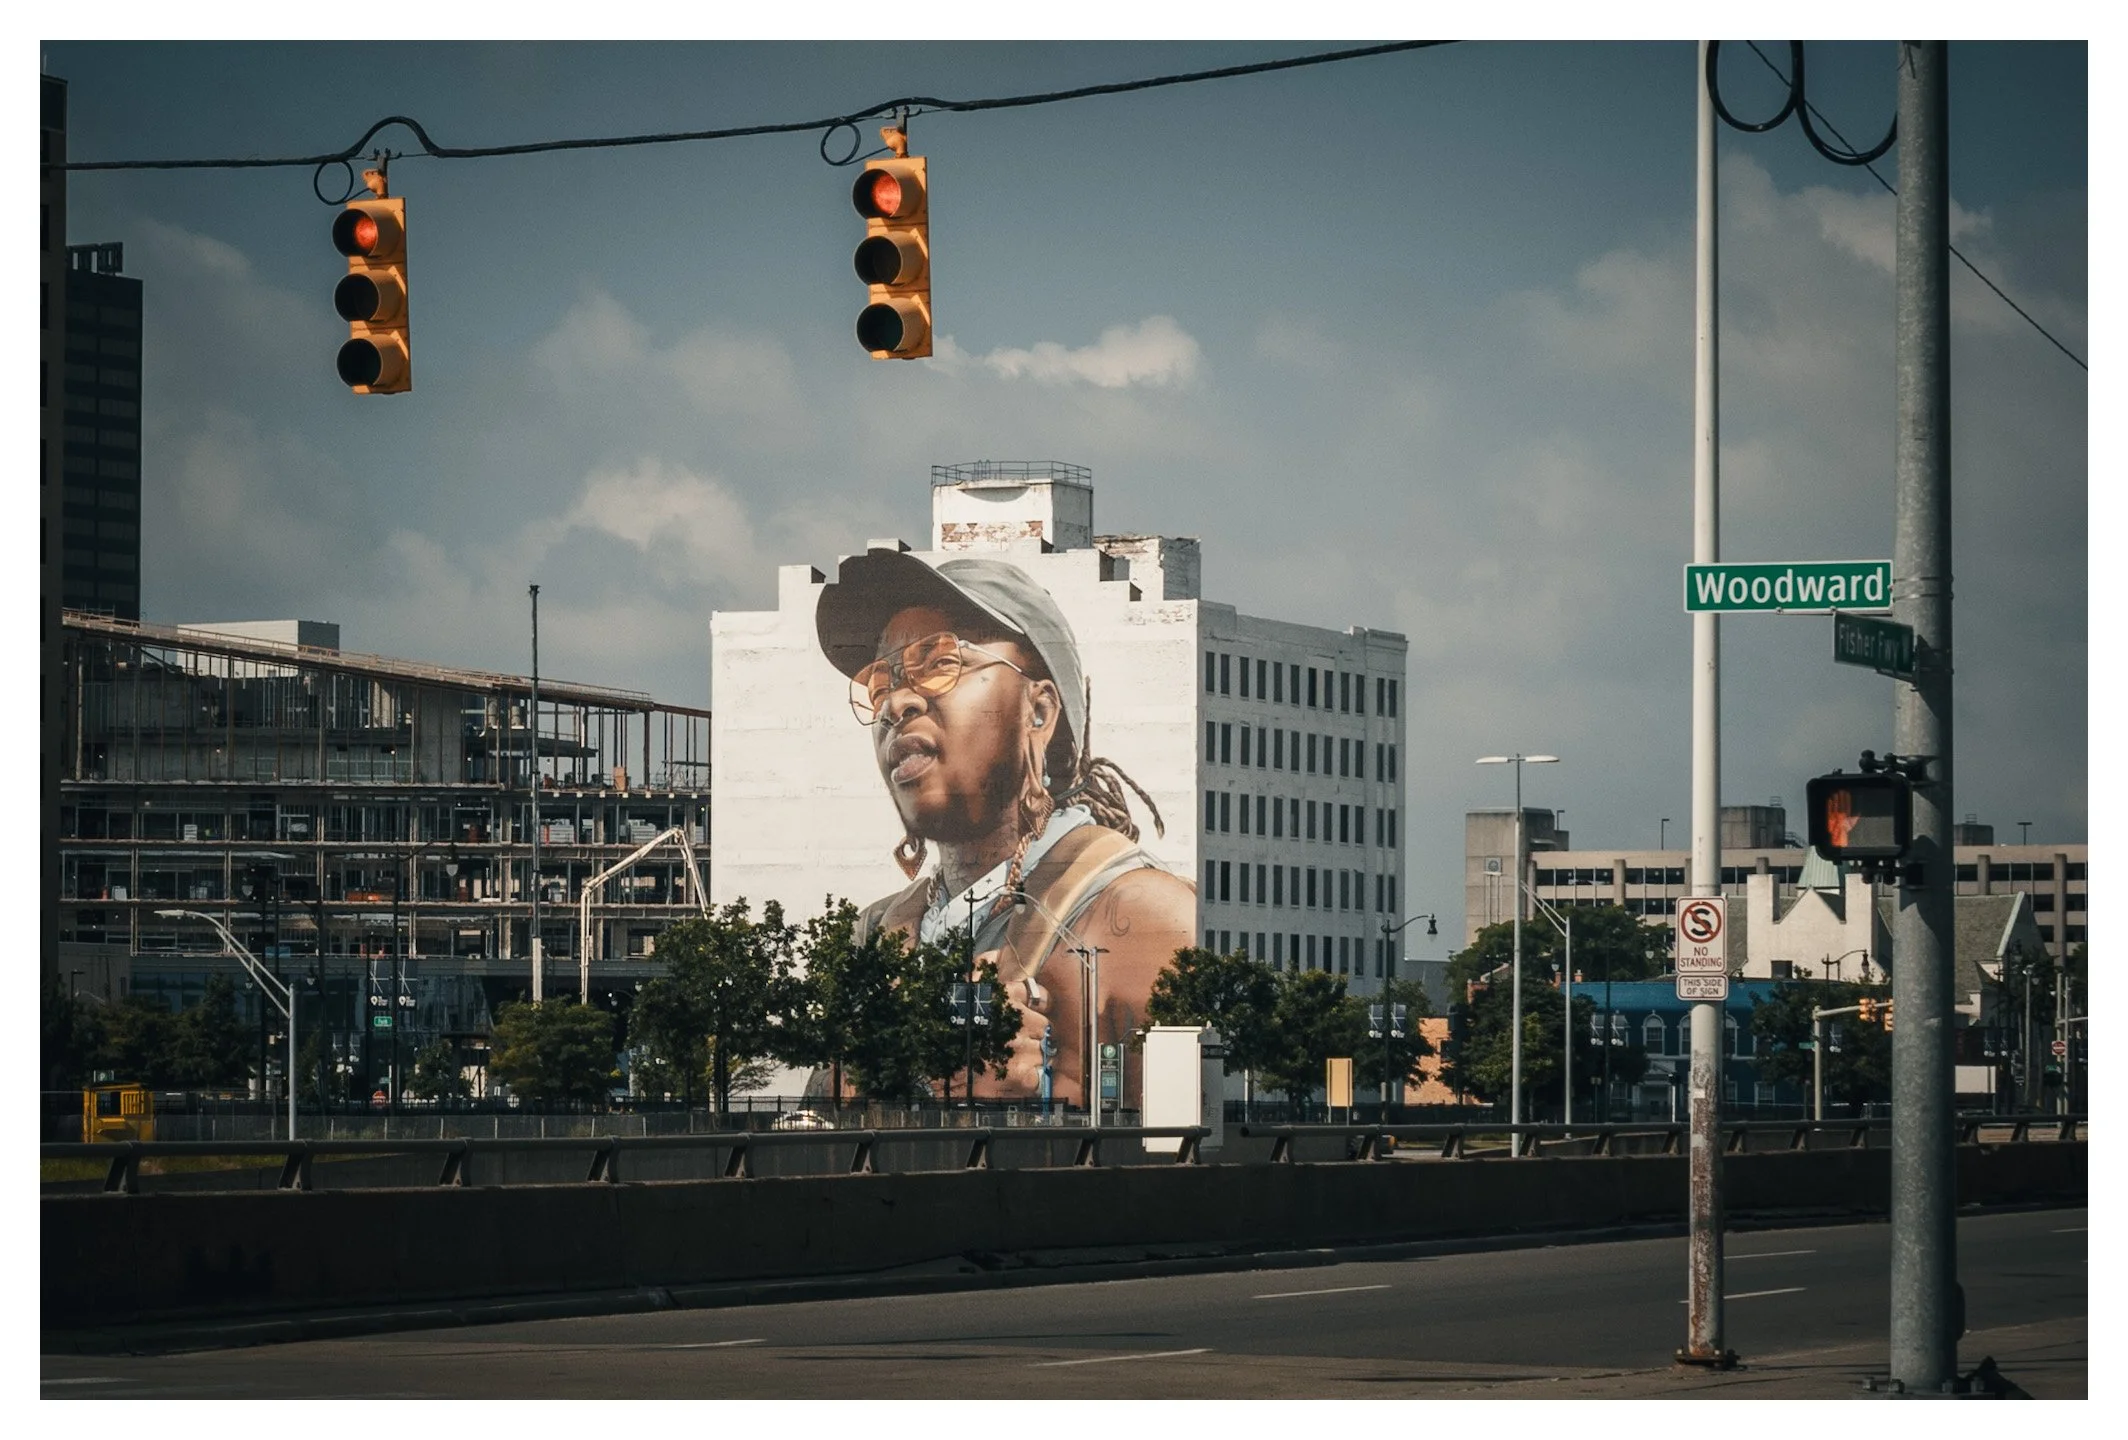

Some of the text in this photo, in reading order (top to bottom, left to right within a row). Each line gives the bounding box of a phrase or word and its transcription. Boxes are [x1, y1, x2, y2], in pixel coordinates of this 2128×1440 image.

[1695, 567, 1883, 604] Woodward
[1838, 623, 1875, 657] Fisher
[1693, 947, 1708, 956] NO
[1680, 958, 1722, 967] STANDING
[1683, 979, 1722, 987] THIS SIDE
[1686, 987, 1719, 995] OF SIGN
